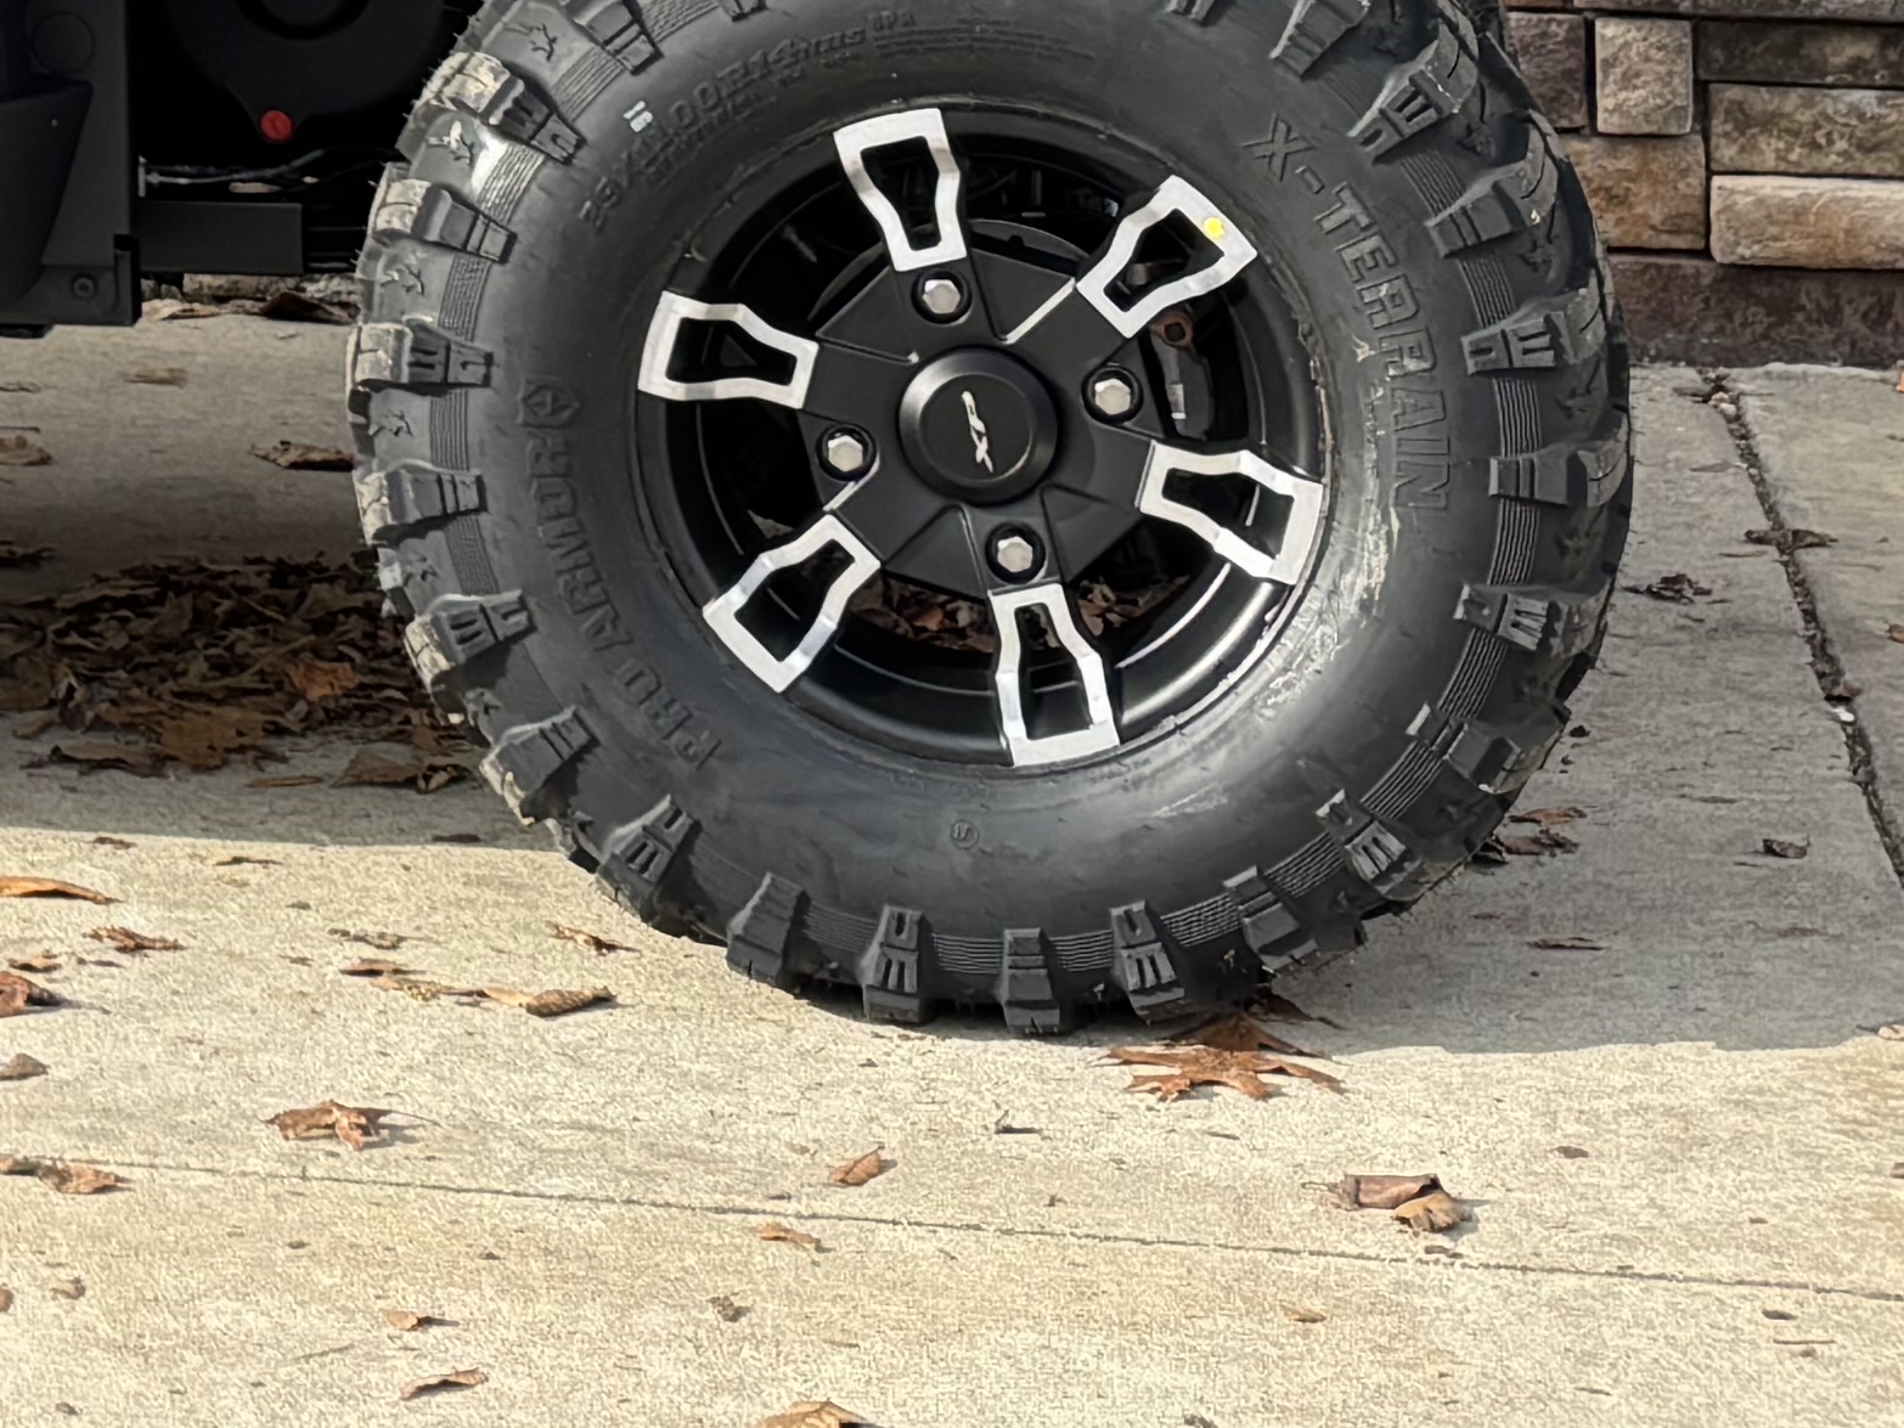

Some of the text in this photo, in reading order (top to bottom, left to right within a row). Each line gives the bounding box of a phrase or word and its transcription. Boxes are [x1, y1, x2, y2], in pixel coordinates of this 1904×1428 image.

[1242, 110, 1452, 510] X-TERRAIN
[525, 434, 723, 772] PRO ARMOR
